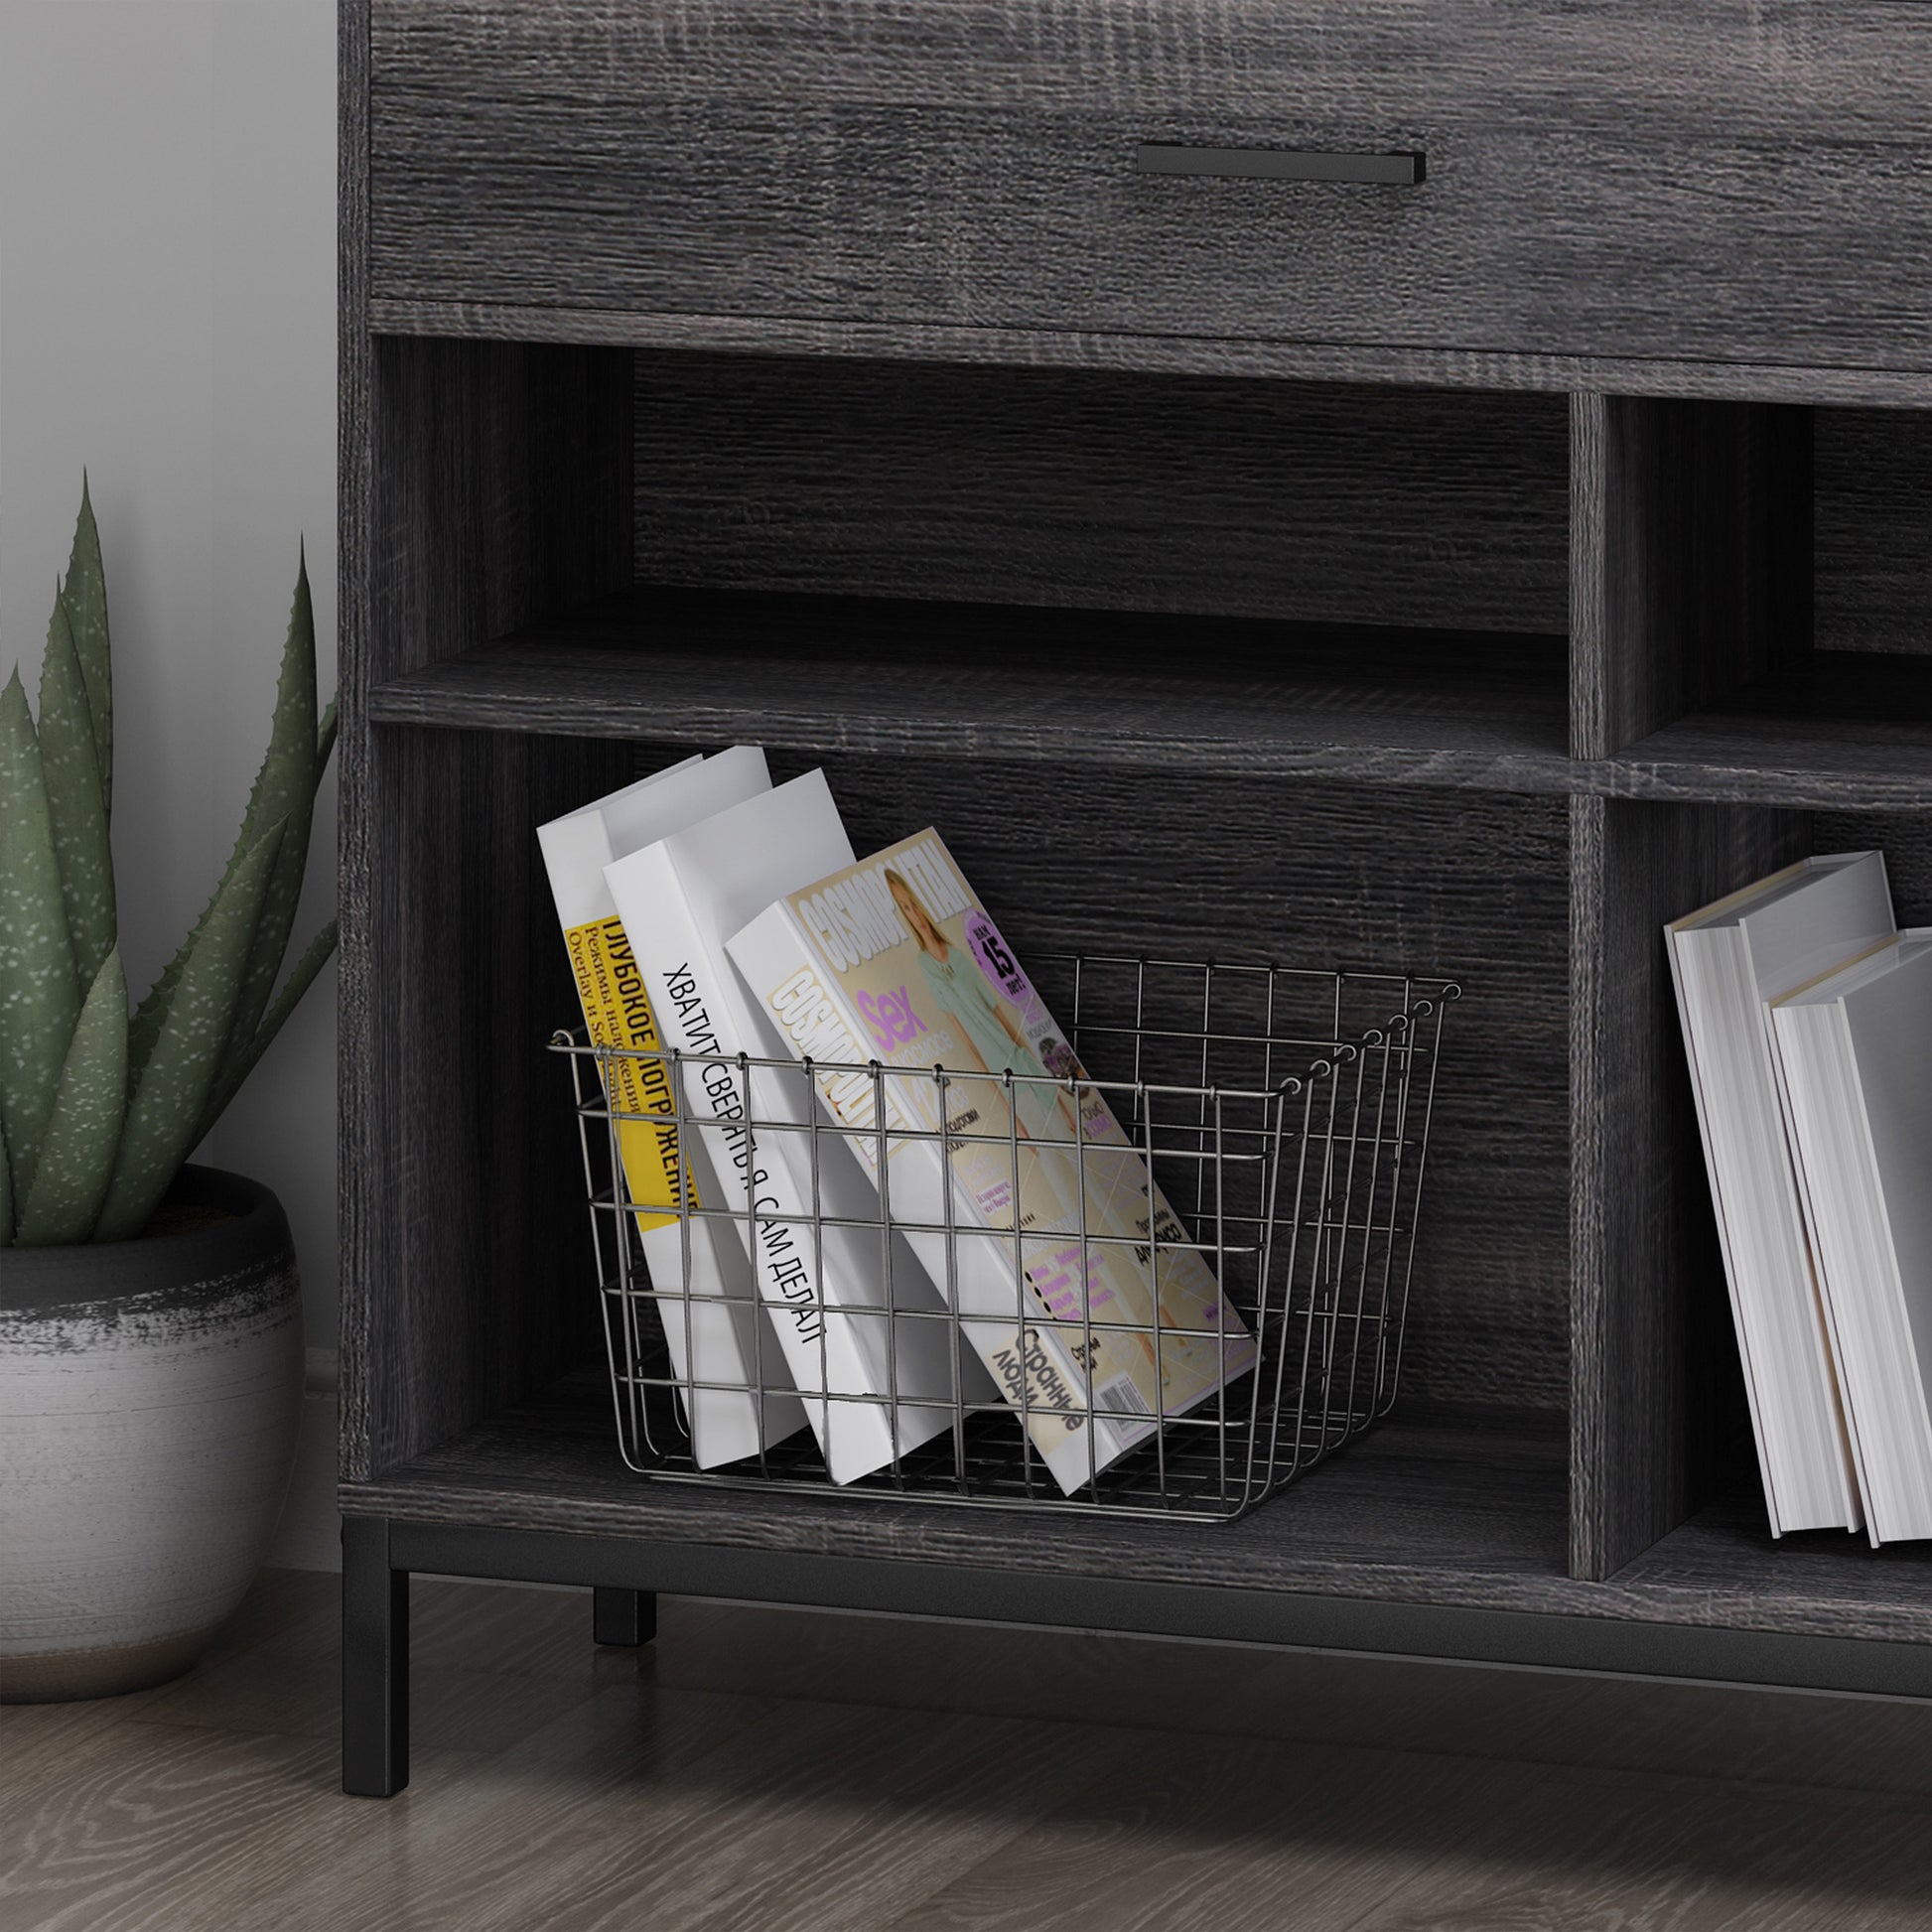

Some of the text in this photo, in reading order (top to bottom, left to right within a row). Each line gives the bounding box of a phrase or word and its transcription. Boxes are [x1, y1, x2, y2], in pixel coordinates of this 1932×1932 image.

[794, 838, 975, 975] COSMOPITAN
[567, 929, 594, 999] Overlay
[584, 925, 613, 1005] Режимы
[977, 934, 1019, 980] 15
[661, 961, 722, 1065] ХВАТИТ
[853, 984, 928, 1051] Sex
[739, 1164, 768, 1193] Я
[750, 1191, 794, 1259] САМ
[766, 1257, 827, 1344] ДЕЛАЛ
